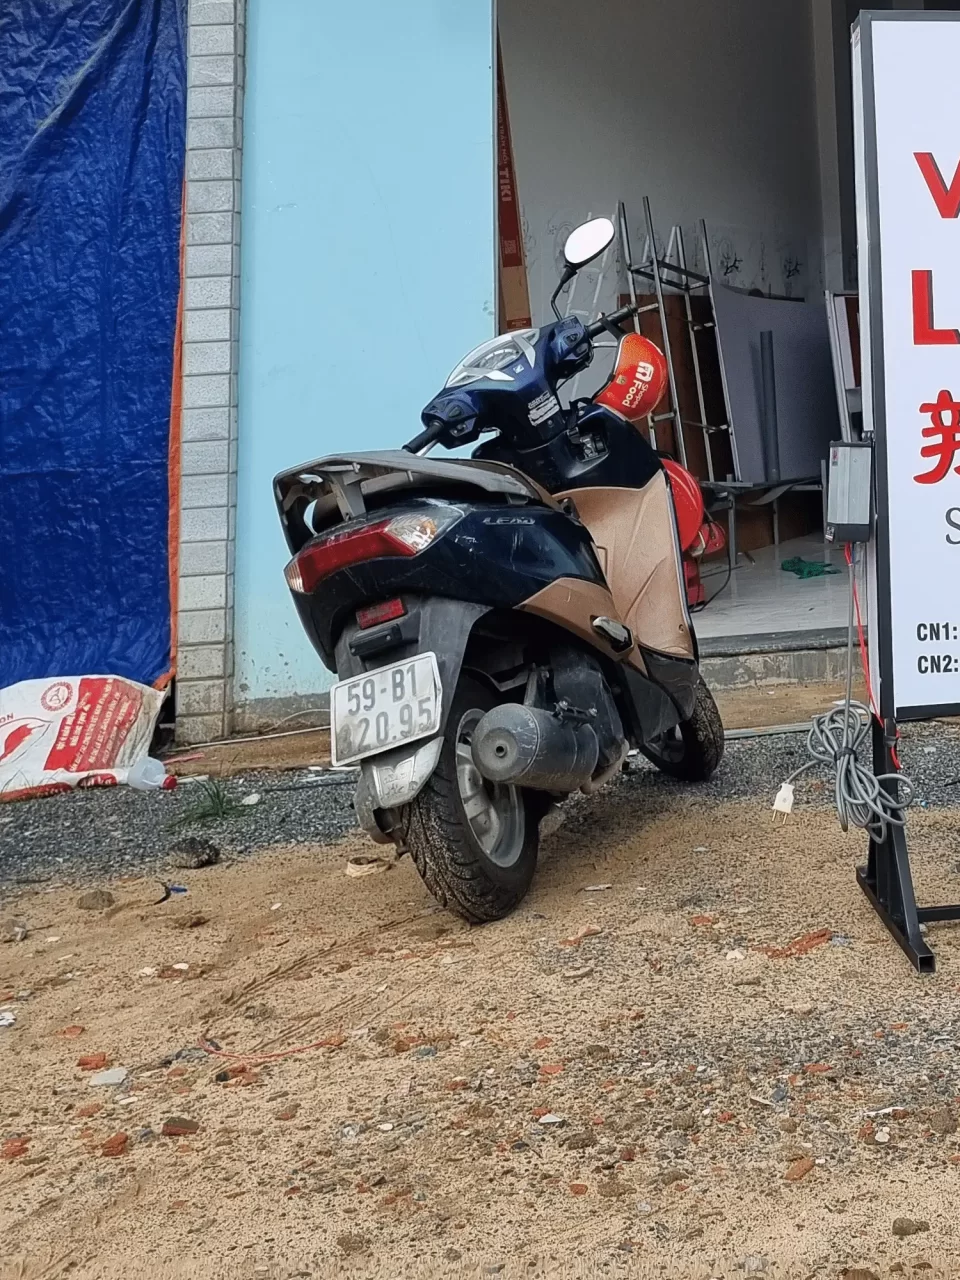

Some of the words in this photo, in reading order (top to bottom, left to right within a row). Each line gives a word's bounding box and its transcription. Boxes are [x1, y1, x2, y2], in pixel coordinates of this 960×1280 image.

[499, 167, 513, 202] TIKI
[621, 379, 643, 408] Food
[916, 620, 958, 642] CN1:
[916, 653, 959, 674] CN2:
[346, 663, 419, 717] 59-B1
